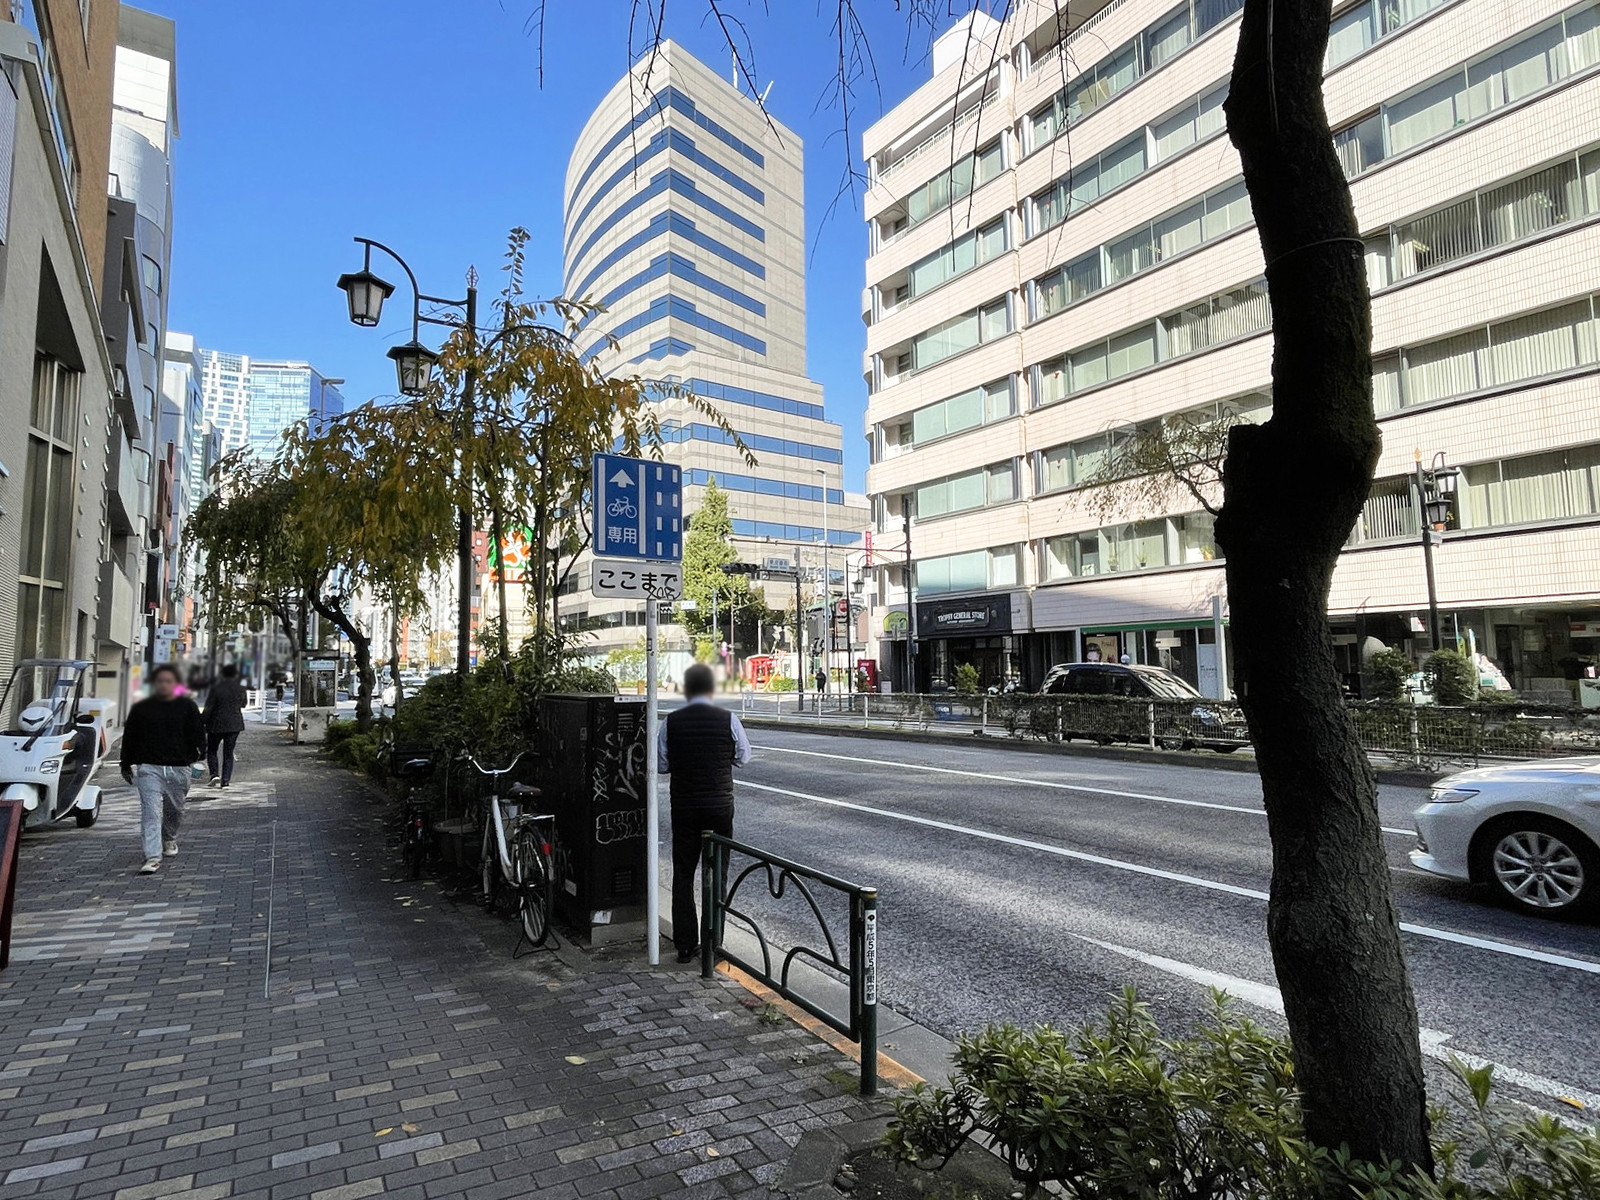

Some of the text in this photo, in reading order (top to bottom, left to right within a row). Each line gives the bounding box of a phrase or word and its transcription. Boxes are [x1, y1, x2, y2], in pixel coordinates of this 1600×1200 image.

[607, 526, 637, 545] 専用
[599, 569, 678, 592] ここまで
[972, 611, 986, 620] STORE
